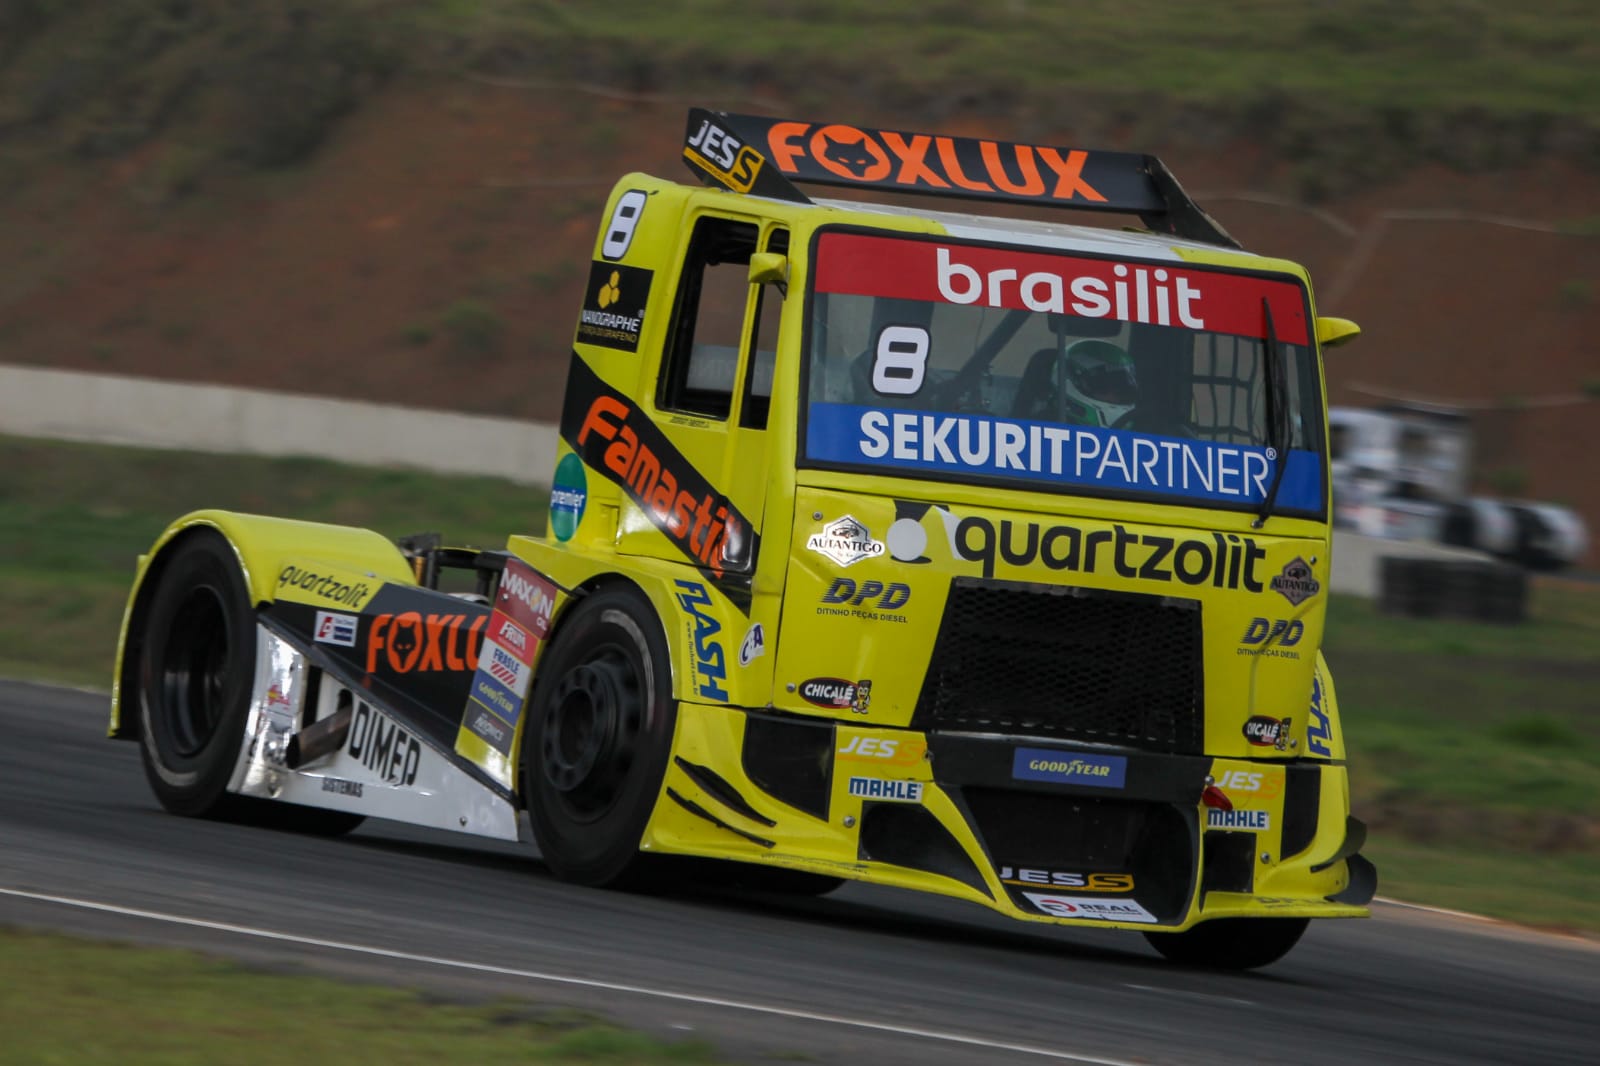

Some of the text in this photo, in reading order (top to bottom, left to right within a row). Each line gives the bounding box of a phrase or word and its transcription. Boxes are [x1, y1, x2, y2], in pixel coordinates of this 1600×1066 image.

[688, 119, 762, 187] JESS
[767, 122, 1109, 202] FOXLUX
[602, 189, 648, 260] 8
[936, 247, 1205, 330] brasilit
[871, 325, 930, 395] 8
[809, 537, 882, 554] AUTANTIGO
[955, 516, 1266, 593] quartzolit
[279, 565, 368, 608] quartzolit
[500, 567, 554, 620] MAXON
[821, 577, 911, 610] DPD
[880, 613, 908, 624] DIESEL
[1240, 617, 1304, 647] DPD
[673, 579, 729, 703] FLASH
[804, 682, 854, 701] CHICALÉ
[839, 735, 924, 762] JESS
[849, 777, 917, 800] MAHLE
[1208, 808, 1265, 828] MAHLE
[1000, 866, 1134, 891] JESS
[1078, 903, 1138, 912] REAL
